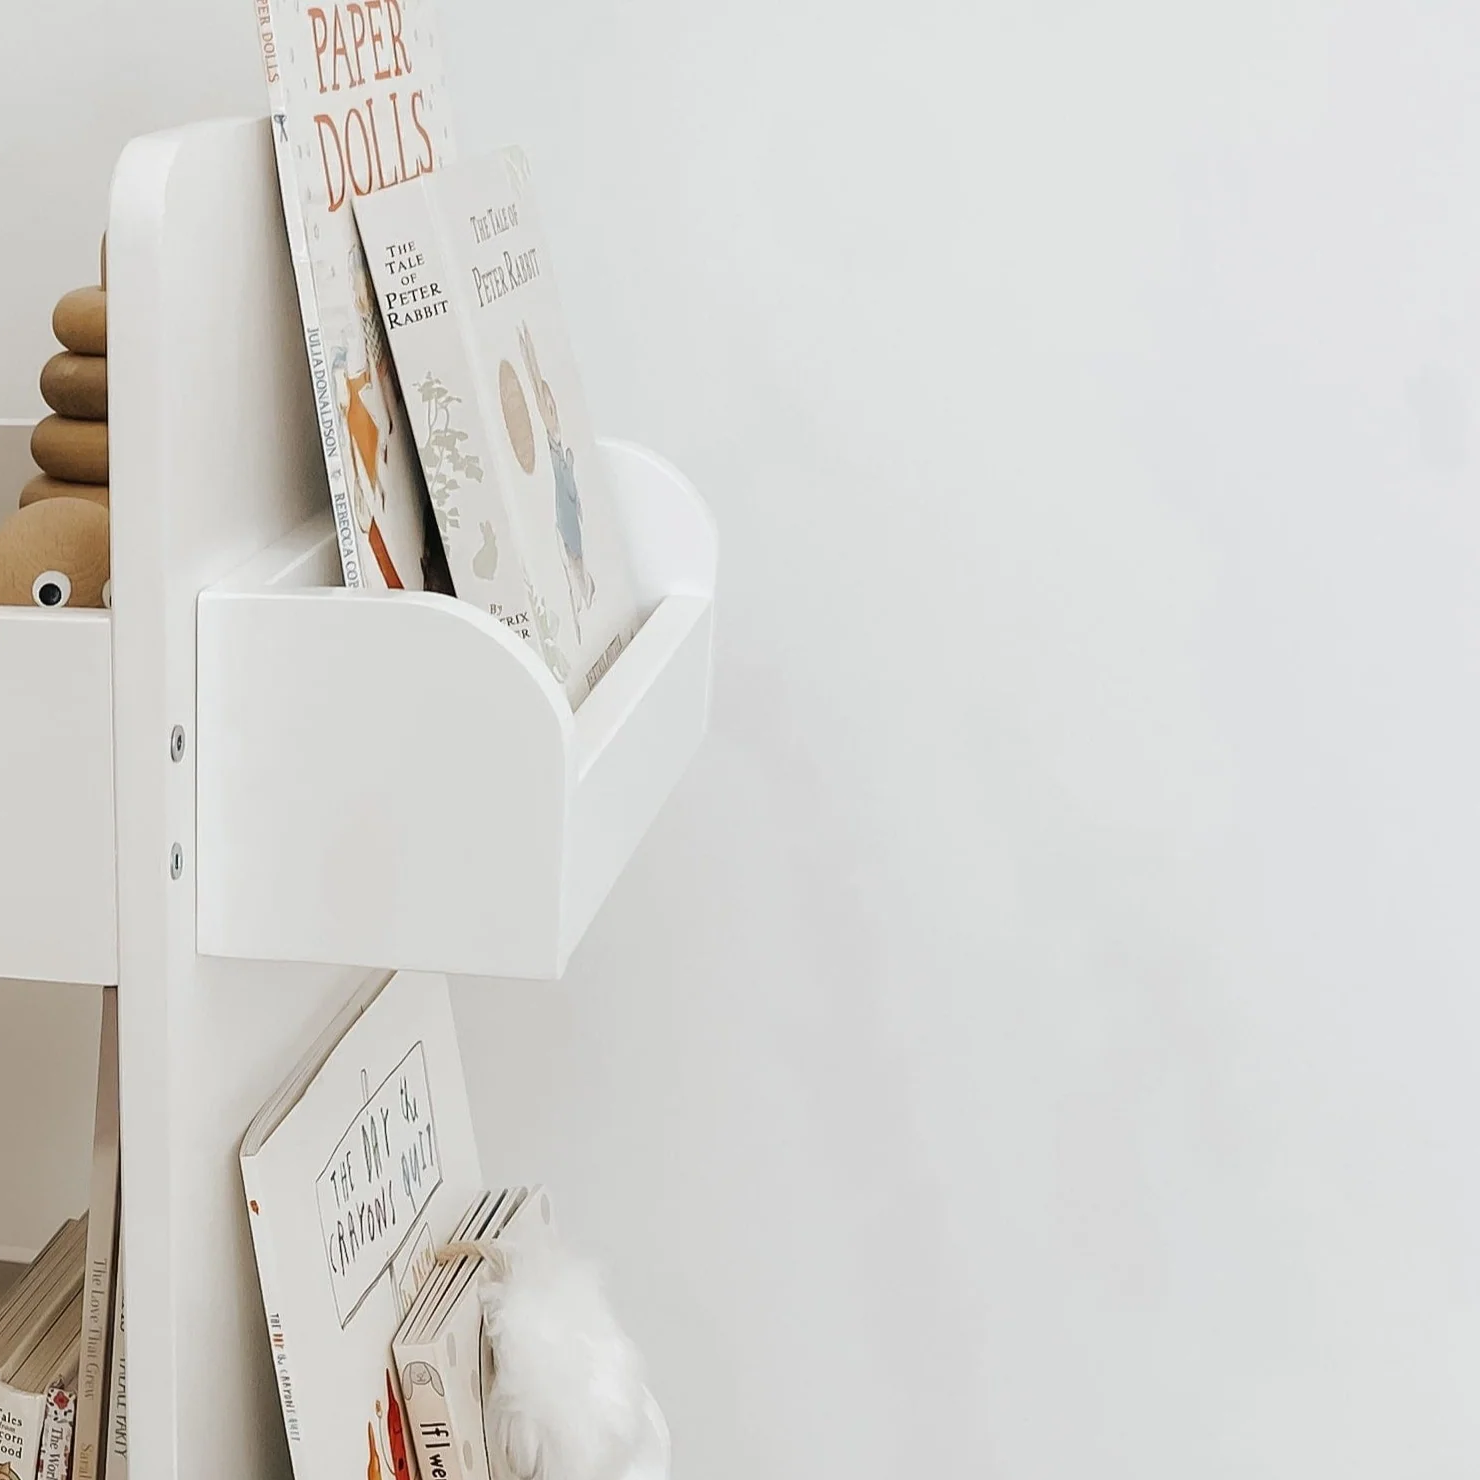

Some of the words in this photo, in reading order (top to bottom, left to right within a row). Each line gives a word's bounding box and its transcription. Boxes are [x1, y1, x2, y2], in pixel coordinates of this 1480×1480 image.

[262, 32, 280, 84] DOLLS
[307, 0, 413, 94] PAPER
[313, 89, 434, 213] DOLLS
[385, 253, 425, 275] TALE
[401, 273, 418, 287] OF
[503, 248, 541, 292] RABBIT
[386, 282, 442, 310] PETER
[387, 299, 449, 330] RABBIT
[307, 327, 324, 368] JULIA
[314, 369, 338, 458] DONALDSON
[334, 492, 354, 558] REBECCA
[330, 1151, 354, 1209] THE
[361, 1107, 390, 1183] DAY
[400, 1076, 418, 1123] the
[330, 1180, 396, 1277] CRAYONS
[401, 1123, 434, 1214] QUIT
[92, 1258, 107, 1286] The
[90, 1289, 105, 1323] Love
[87, 1327, 102, 1359] That
[85, 1362, 99, 1398] Grew
[50, 1428, 63, 1450] The
[420, 1422, 449, 1438] If
